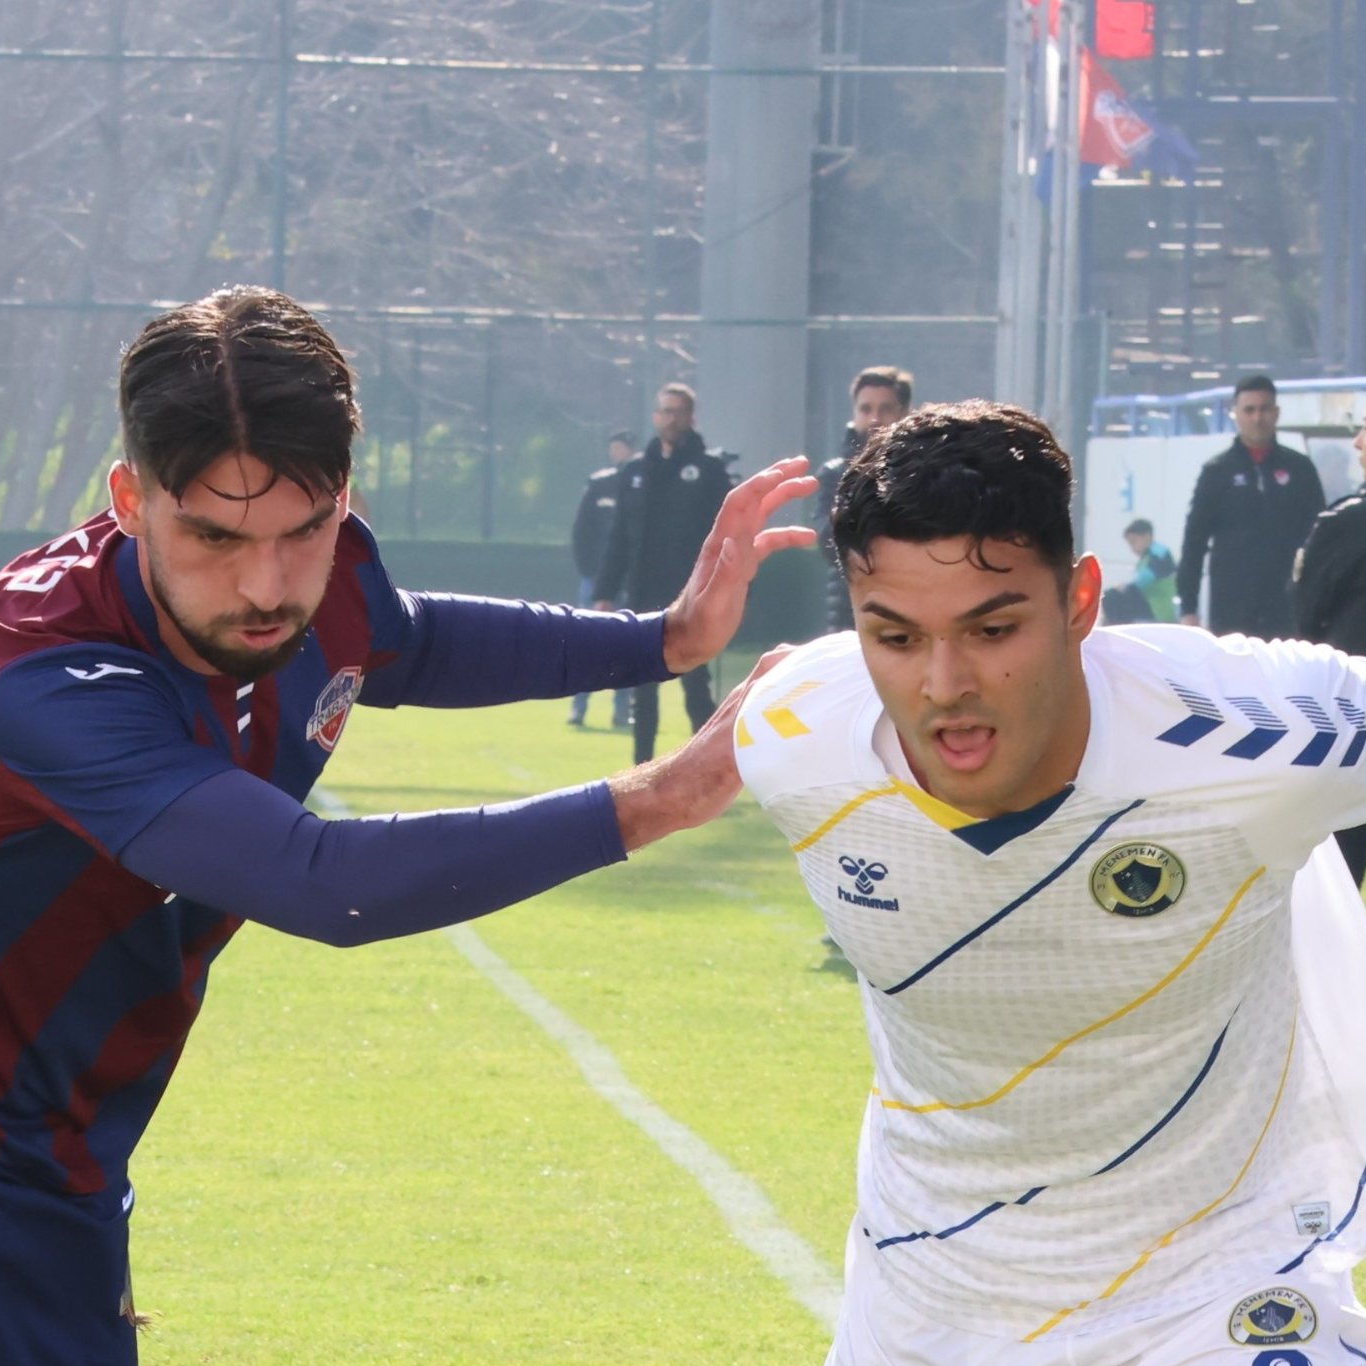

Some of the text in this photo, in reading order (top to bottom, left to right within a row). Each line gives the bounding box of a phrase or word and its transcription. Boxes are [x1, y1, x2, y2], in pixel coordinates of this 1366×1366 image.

[1099, 848, 1156, 877] MENEMEN
[838, 885, 899, 911] hummel
[1236, 1290, 1294, 1317] MENEMEN
